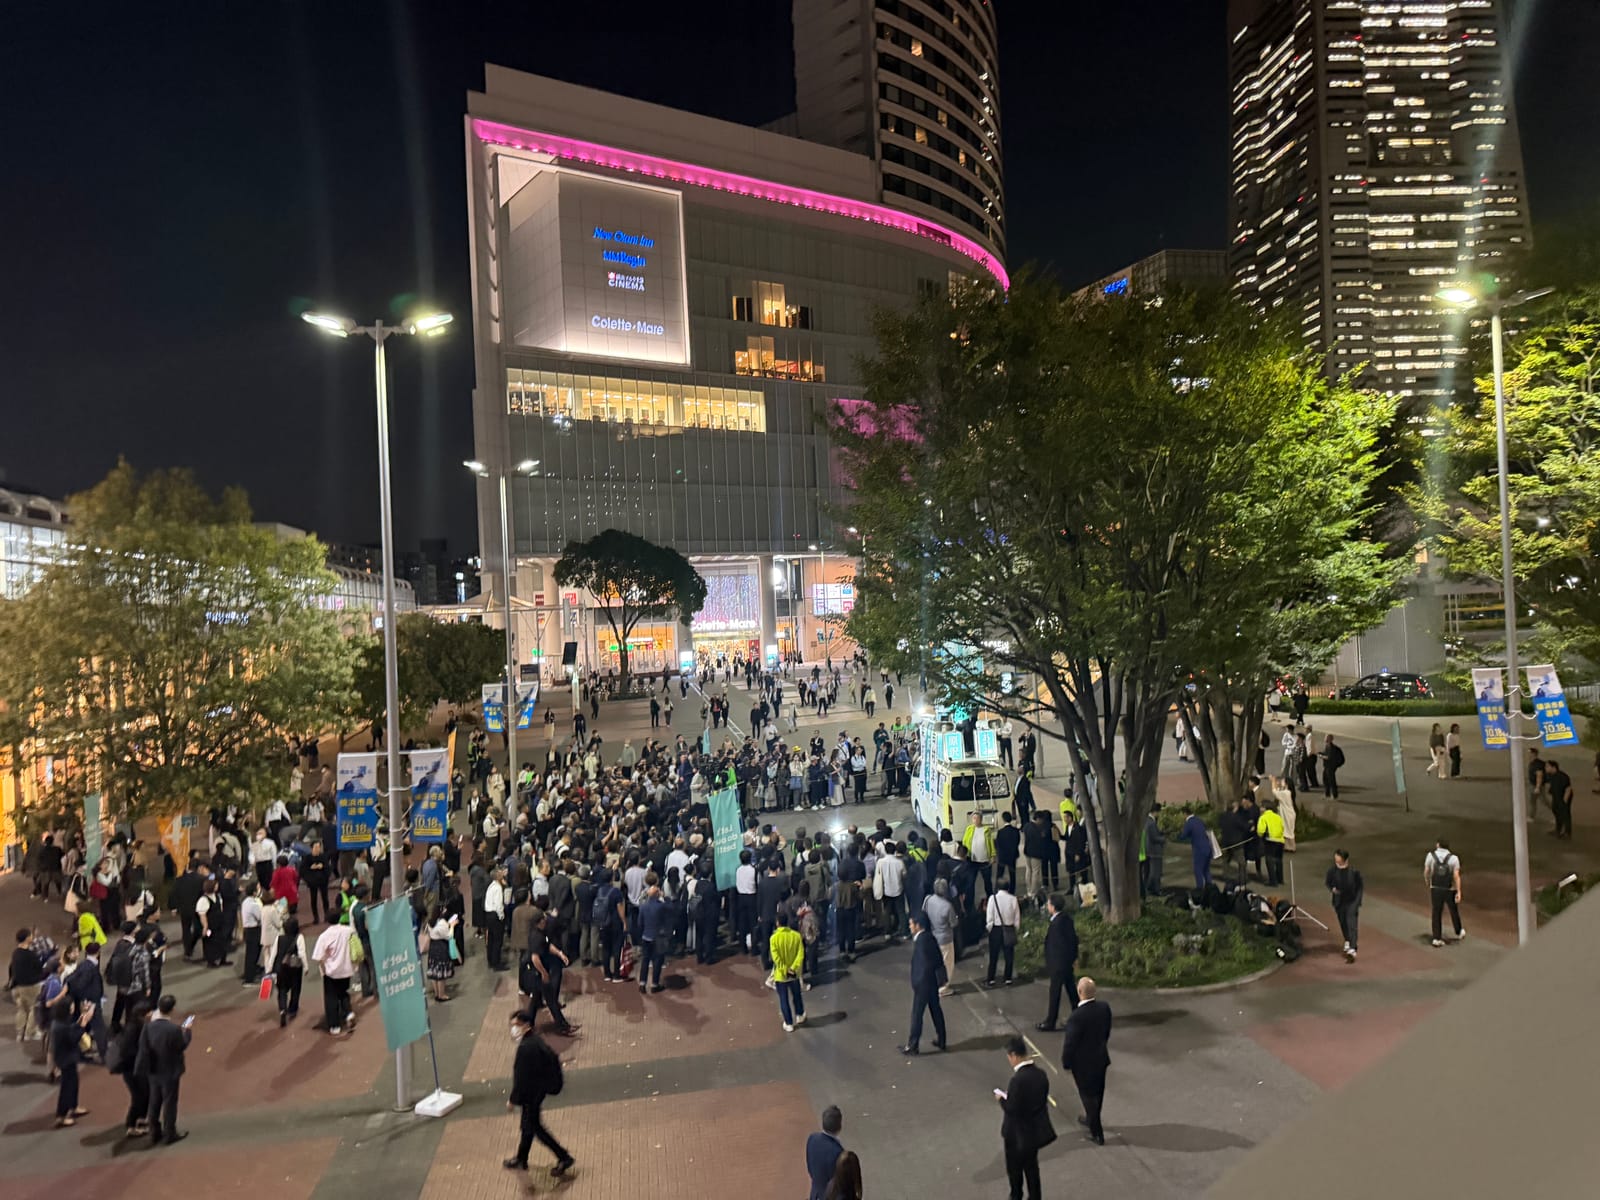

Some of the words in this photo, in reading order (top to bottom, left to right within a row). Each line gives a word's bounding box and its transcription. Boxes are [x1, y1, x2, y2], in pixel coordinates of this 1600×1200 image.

[593, 227, 613, 241] New
[640, 235, 654, 248] Inn
[608, 279, 645, 291] CINEMA
